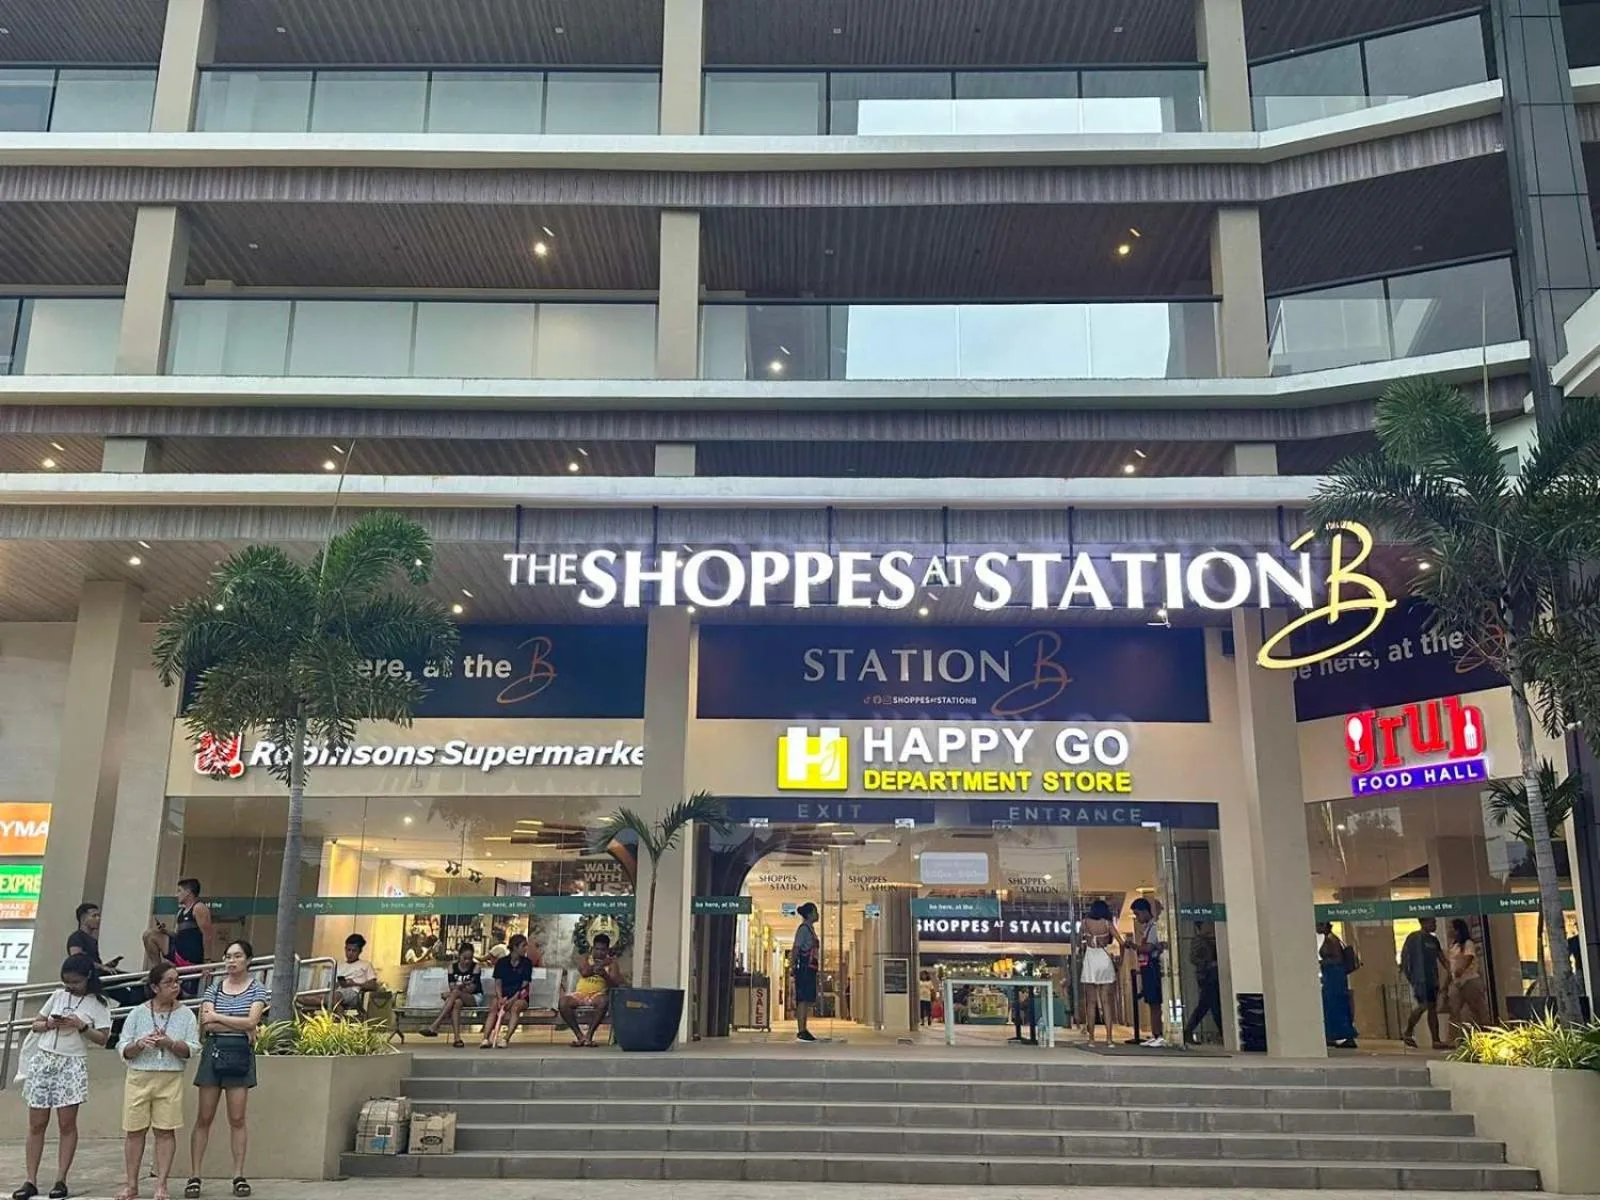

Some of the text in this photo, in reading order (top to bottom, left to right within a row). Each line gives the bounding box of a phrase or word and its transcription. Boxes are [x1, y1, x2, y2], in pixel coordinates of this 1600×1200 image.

[504, 553, 577, 585] THE
[578, 549, 916, 609] SHOPPES
[921, 555, 969, 588] AT
[972, 550, 1315, 610] STATION
[1388, 637, 1413, 662] at
[1419, 629, 1464, 656] the
[463, 654, 513, 678] the
[803, 648, 1011, 683] STATION
[863, 727, 1130, 766] HAPPY GO
[1345, 695, 1487, 773] grub
[863, 770, 1133, 793] DEPARTMENT STORE
[1358, 765, 1479, 792] FOOD HALL
[798, 804, 863, 819] EXIT
[1008, 806, 1143, 824] ENTRANCE
[584, 863, 623, 872] WALK
[756, 988, 764, 1025] SALE
